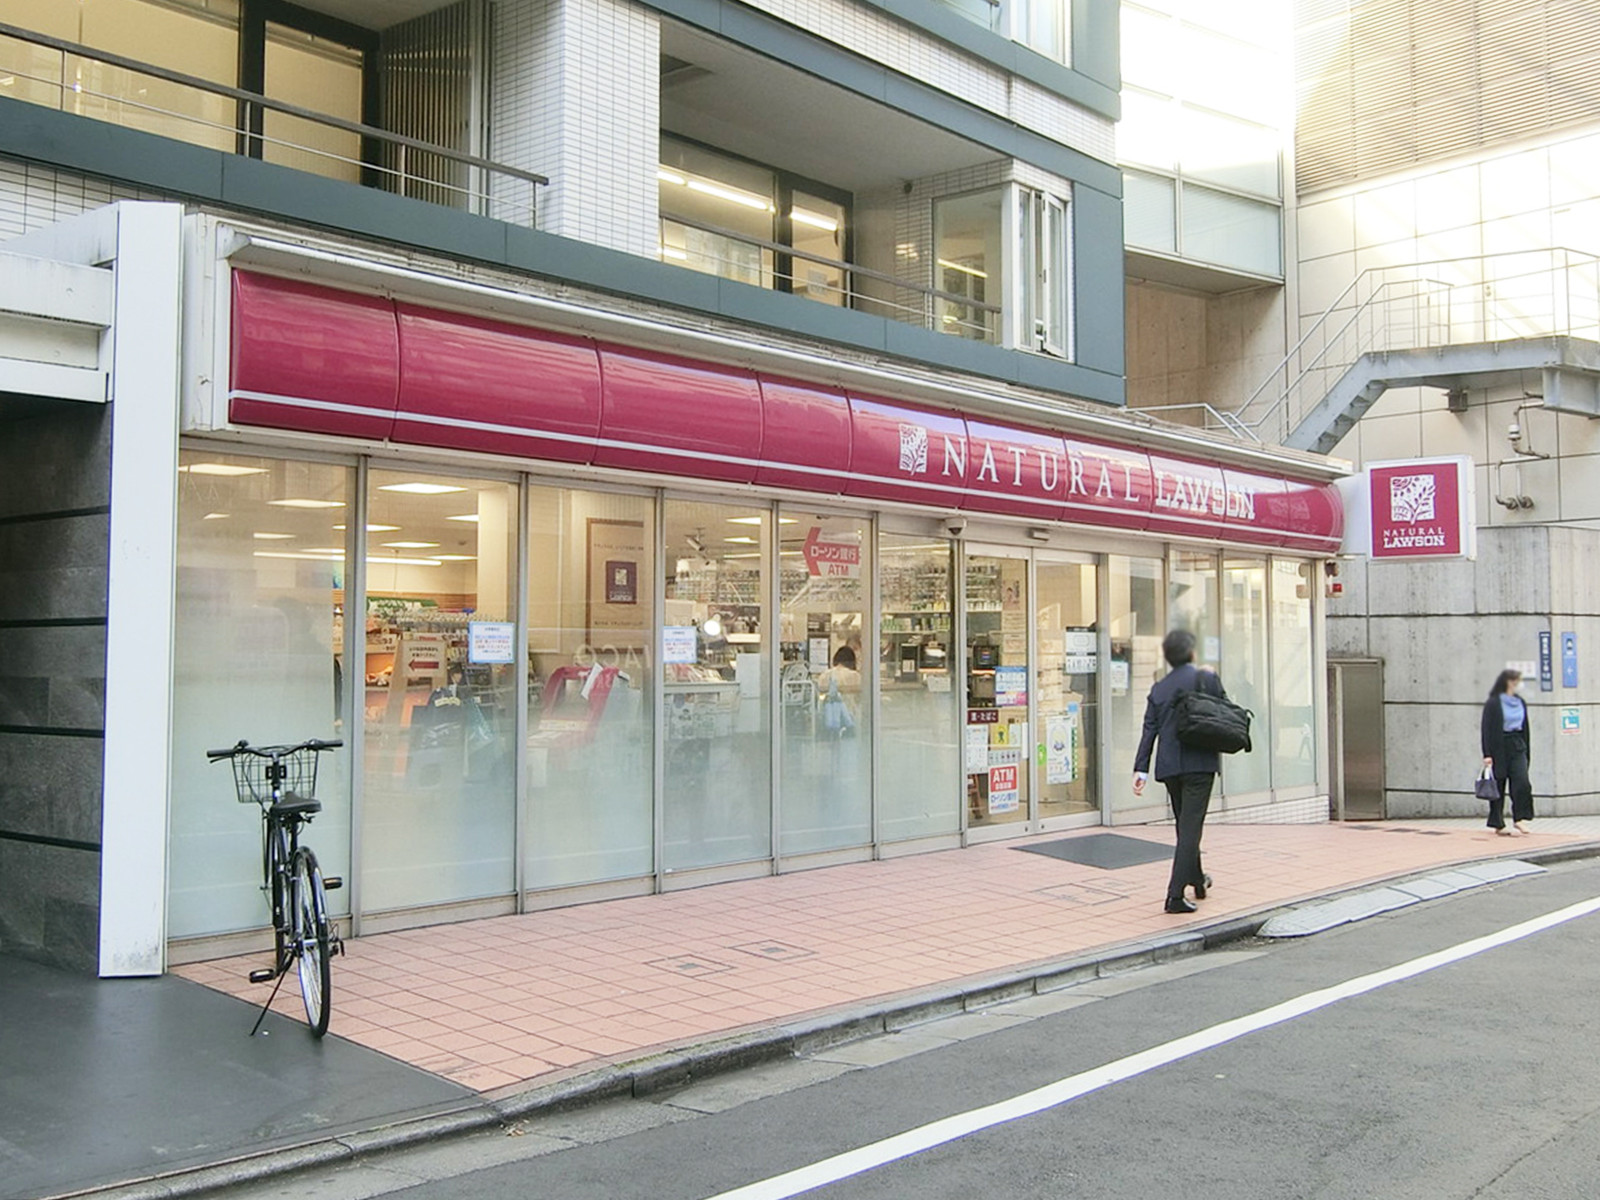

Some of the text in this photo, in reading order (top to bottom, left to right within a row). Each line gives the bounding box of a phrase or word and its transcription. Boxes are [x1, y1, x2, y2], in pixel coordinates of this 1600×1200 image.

[941, 435, 1256, 520] NATURAL LAWSON
[1383, 527, 1445, 536] NATURAL
[1383, 535, 1445, 549] LAWSON
[828, 564, 849, 576] ATM
[993, 768, 1015, 783] ATM
